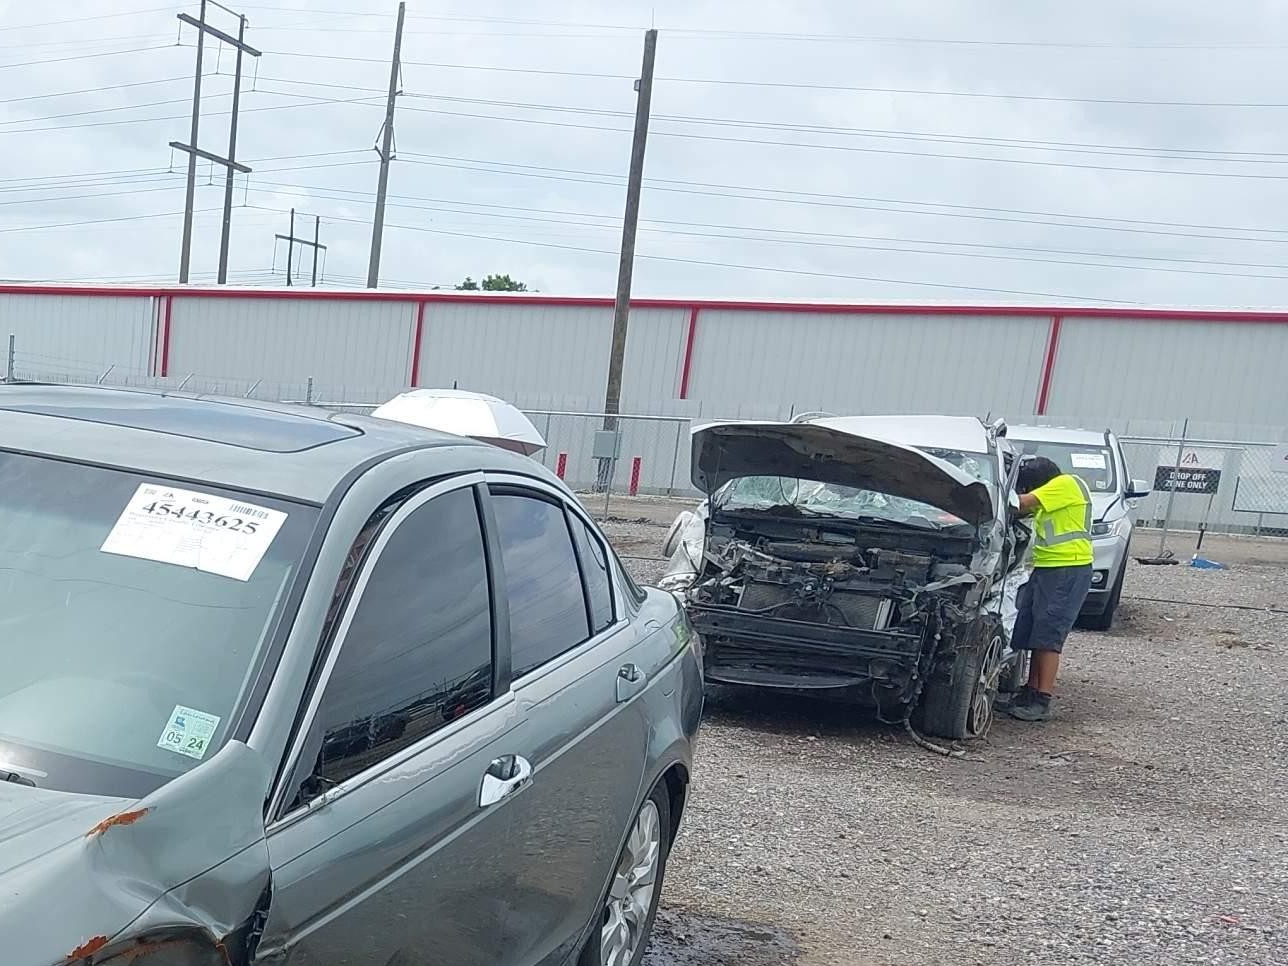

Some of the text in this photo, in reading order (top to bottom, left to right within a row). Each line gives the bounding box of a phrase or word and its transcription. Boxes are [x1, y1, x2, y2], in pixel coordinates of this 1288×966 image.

[1192, 473, 1207, 481] OFF
[1187, 481, 1208, 489] ONLY
[142, 501, 261, 535] 45443625
[167, 731, 204, 750] 05 24
